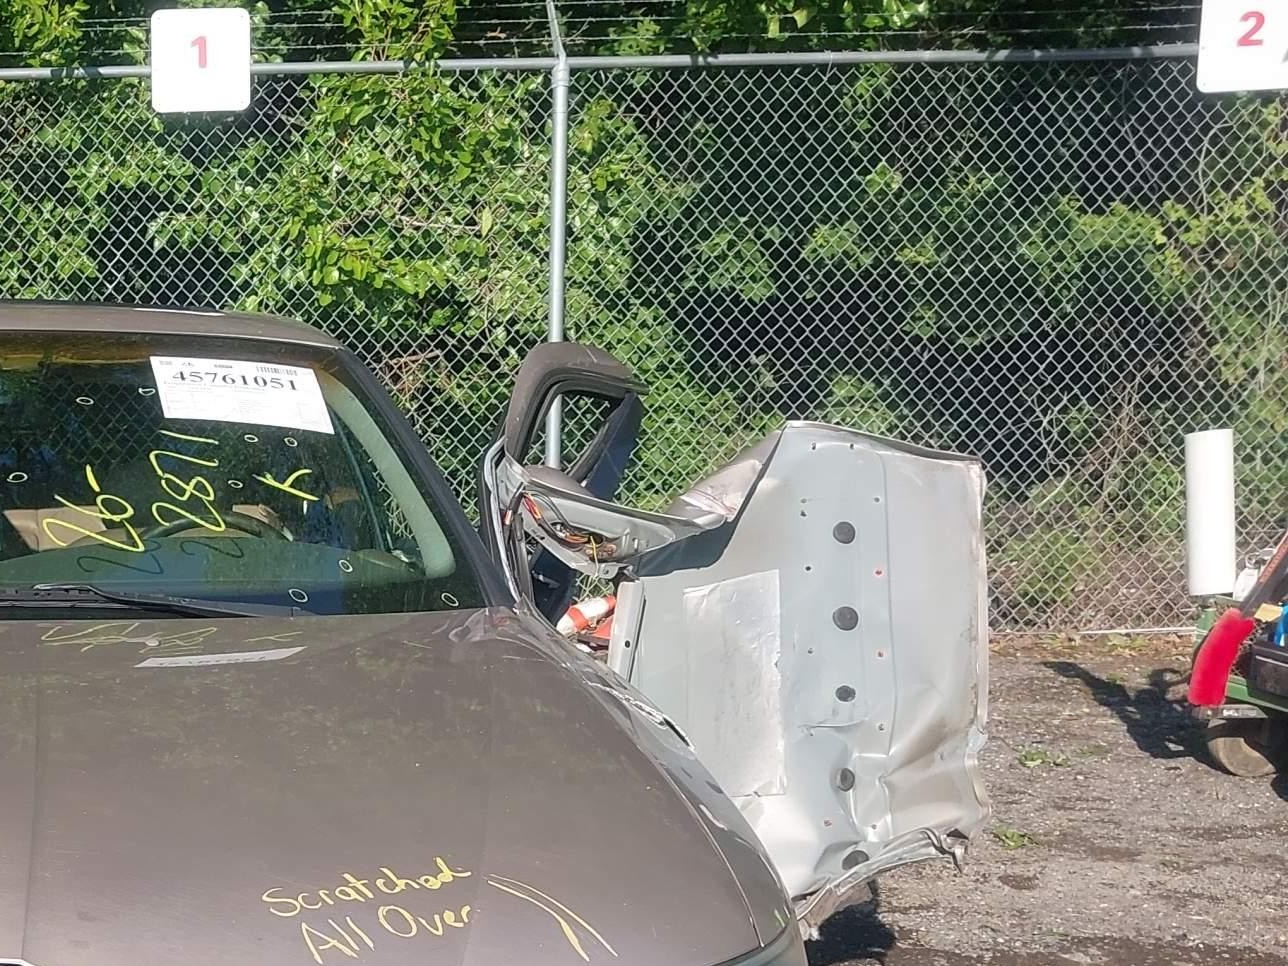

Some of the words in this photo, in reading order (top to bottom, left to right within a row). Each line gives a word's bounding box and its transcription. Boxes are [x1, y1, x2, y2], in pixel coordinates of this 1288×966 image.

[1237, 10, 1265, 47] 2
[190, 35, 208, 69] 1
[172, 369, 298, 391] 45761051
[301, 916, 375, 965] All
[377, 904, 472, 938] Over
